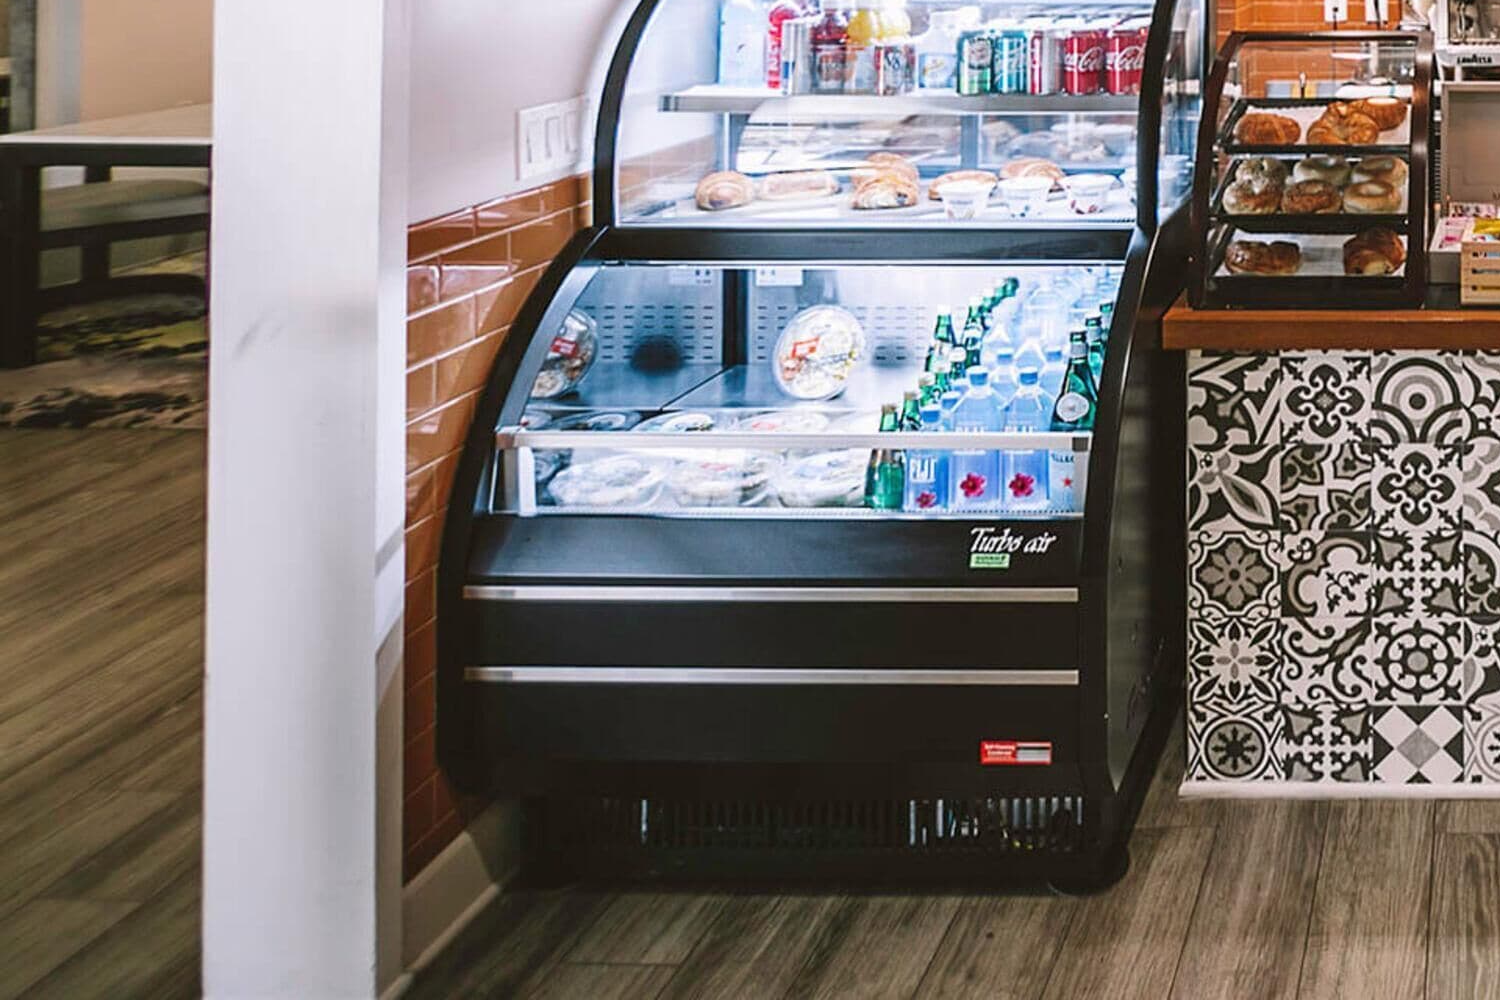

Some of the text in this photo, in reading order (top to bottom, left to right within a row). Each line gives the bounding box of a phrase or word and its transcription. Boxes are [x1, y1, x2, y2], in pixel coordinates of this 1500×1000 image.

[909, 456, 938, 484] FIJI
[970, 527, 1057, 553] Turbo air
